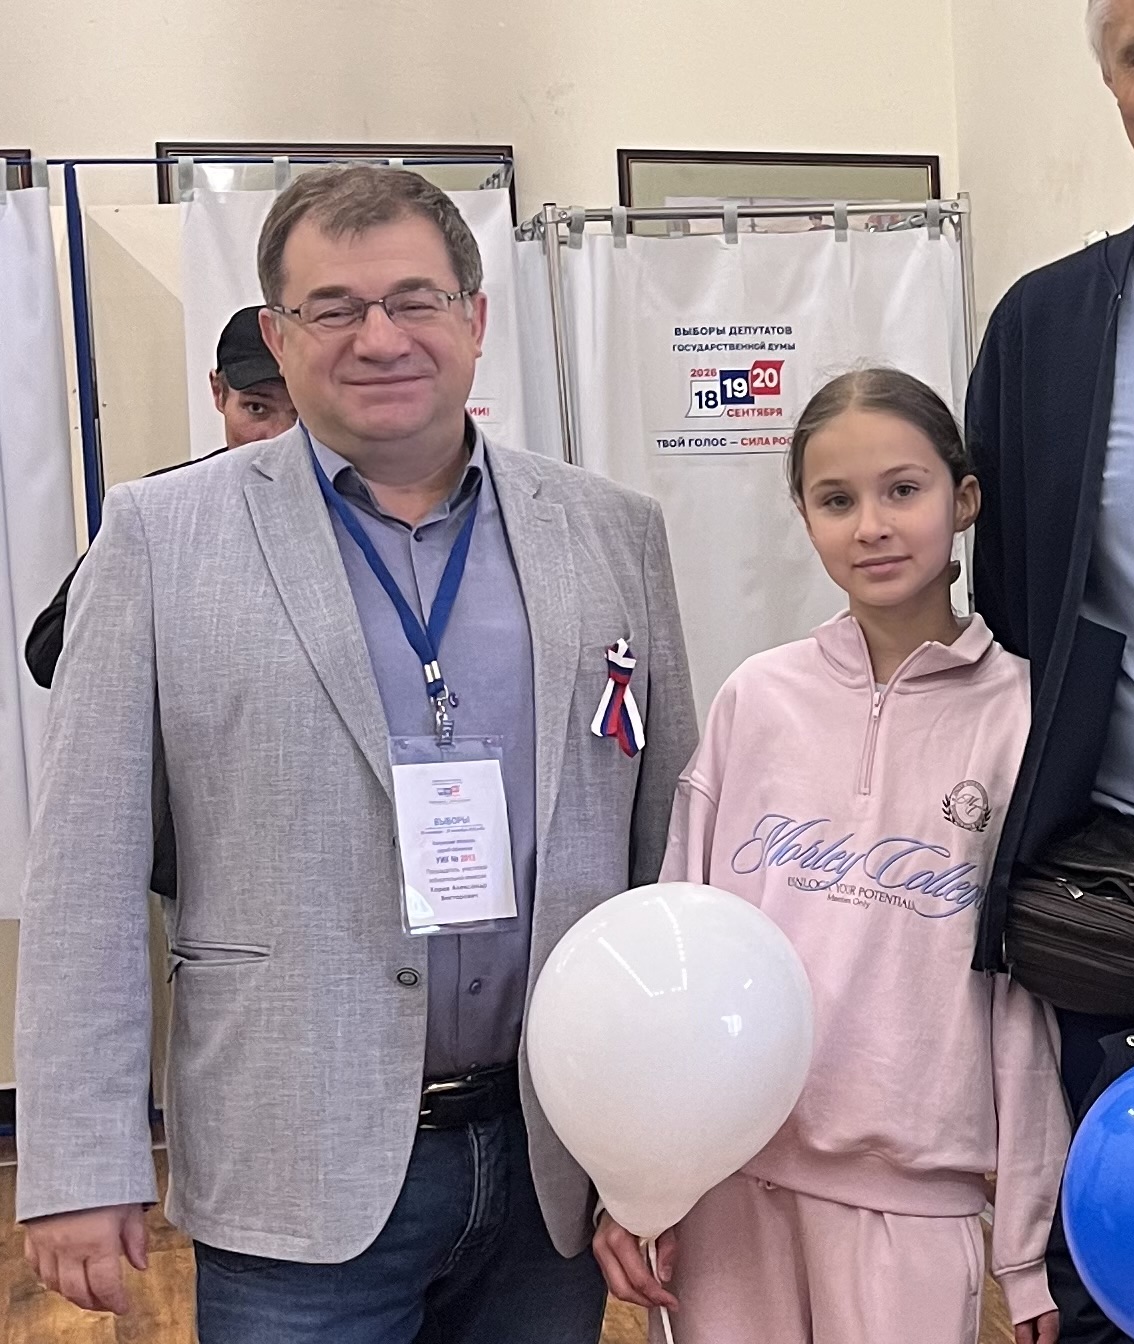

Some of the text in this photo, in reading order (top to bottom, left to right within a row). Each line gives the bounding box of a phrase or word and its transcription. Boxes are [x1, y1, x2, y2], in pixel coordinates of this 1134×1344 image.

[674, 326, 793, 336] ВЫБОРЫ ДЕПУТАТОВ
[672, 341, 796, 352] ГОСУДАРСТВЕННОЙ ДУМЫ
[690, 368, 717, 377] 2026
[694, 367, 778, 409] 18 19 20
[470, 407, 490, 416] ИИ!
[726, 408, 783, 418] СЕНТЯБРЯ
[656, 436, 685, 448] ТВОЙ
[688, 437, 727, 447] ГОЛОС
[740, 437, 770, 446] СИЛА
